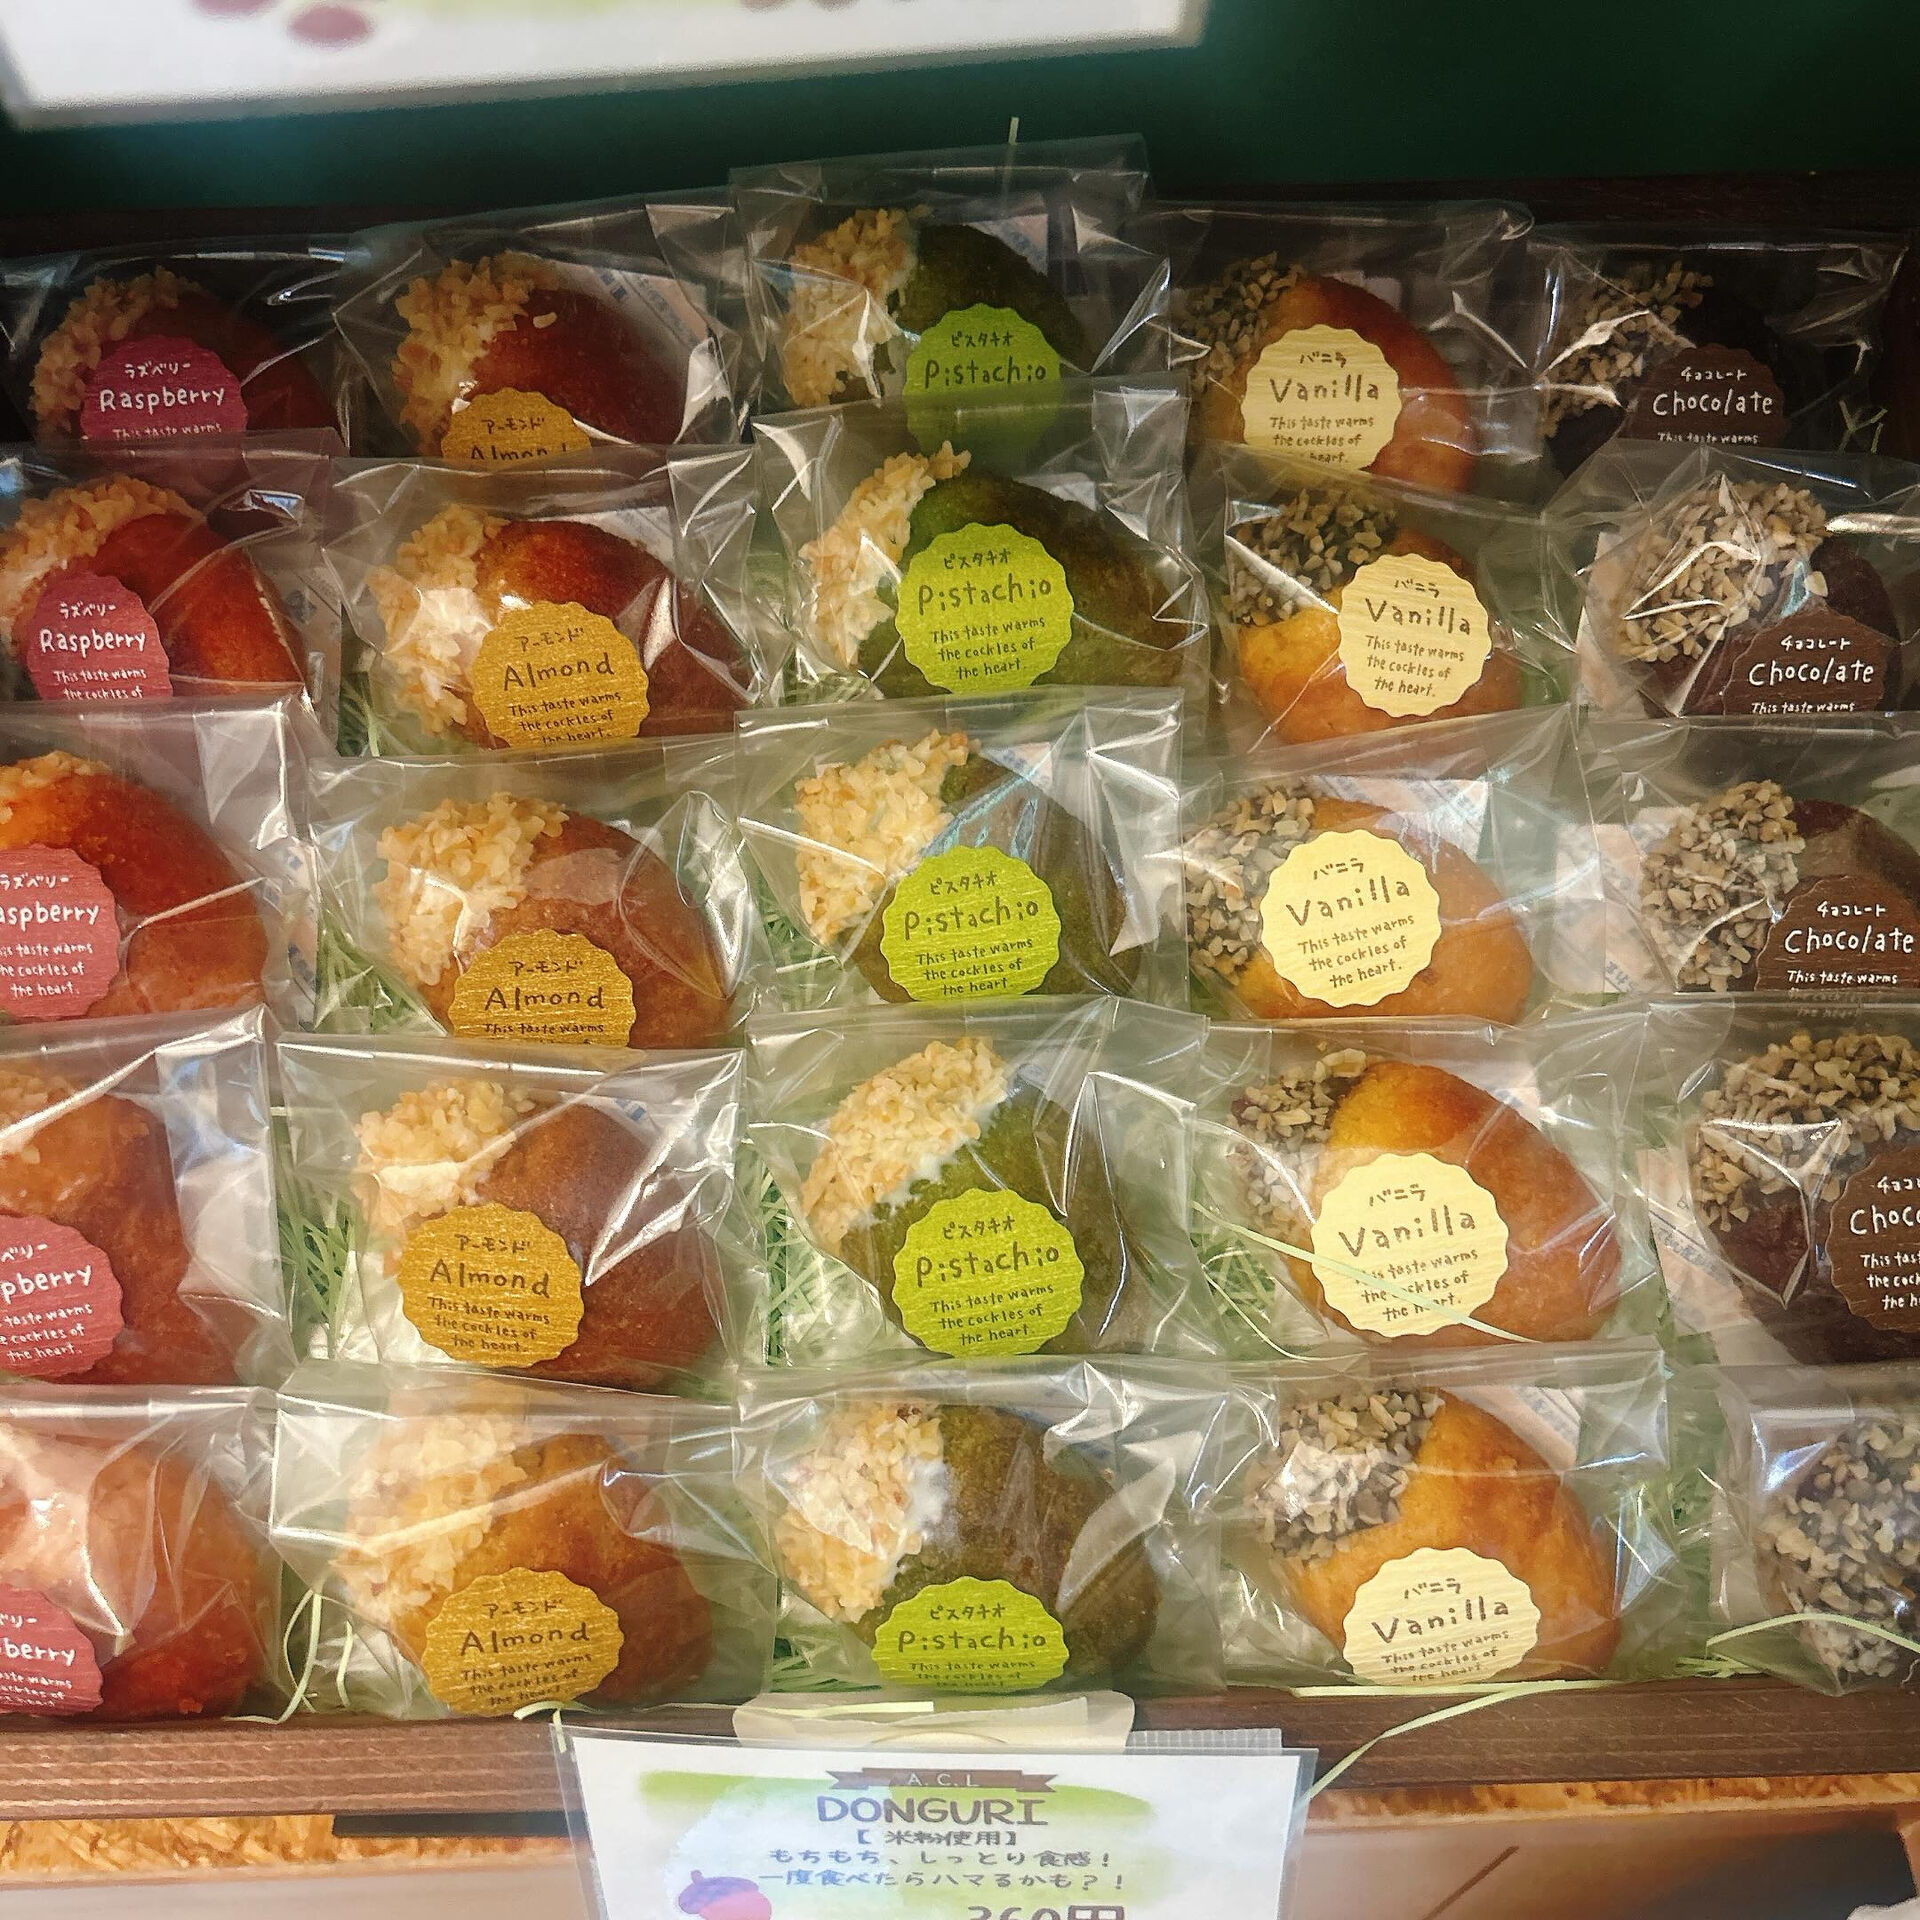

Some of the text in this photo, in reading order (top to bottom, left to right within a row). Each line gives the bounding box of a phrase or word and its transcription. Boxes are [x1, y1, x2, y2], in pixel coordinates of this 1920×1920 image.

[951, 329, 1013, 348] ピスタチオ
[125, 361, 191, 379] ラズベリー
[1300, 351, 1347, 368] バニラ
[924, 355, 1047, 389] Pistachio
[1270, 374, 1379, 403] Vanilla
[100, 386, 225, 416] Raspberry
[1653, 388, 1773, 416] Chocolate
[1270, 416, 1374, 430] This taste warms
[1273, 434, 1293, 446] the
[1348, 434, 1362, 446] of
[944, 548, 1011, 569] ピスタチオ
[918, 573, 1051, 616] Pistachio
[1394, 579, 1439, 598] バニラ
[60, 601, 116, 619] ラズベリー
[1365, 598, 1470, 636] Vanilla
[931, 617, 1045, 643] This taste warms
[40, 628, 145, 658] Raspberry
[938, 637, 1035, 661] the cockles of
[1365, 634, 1464, 661] This taste warms
[54, 668, 147, 684] This taste warms
[504, 652, 614, 691] Almond
[957, 666, 978, 679] the
[1367, 655, 1451, 679] the cockles of
[1749, 657, 1874, 686] Chocolate
[131, 685, 143, 699] of
[1374, 677, 1393, 692] the
[508, 692, 621, 717] This taste warms
[1752, 702, 1855, 715] This taste warms
[519, 709, 613, 731] the cockles of
[1314, 858, 1364, 880] バニラ
[930, 870, 997, 895] ピスタチオ
[1286, 875, 1410, 926] Vanilla
[1817, 900, 1887, 918] チョコレート
[904, 896, 1039, 941] Pistachio
[1297, 915, 1415, 955] This taste warms
[1784, 925, 1914, 954] Chocolate
[16, 944, 49, 957] taste
[53, 943, 93, 954] warms
[915, 938, 1033, 965] This taste warms
[1309, 935, 1407, 972] the cockles of
[18, 964, 69, 976] cockles
[71, 961, 84, 975] of
[509, 961, 583, 976] アーモンド
[924, 958, 1022, 981] the cockles of
[1329, 958, 1402, 988] the heart.
[1787, 970, 1898, 984] This taste warms
[11, 984, 33, 998] the
[485, 986, 605, 1011] Almond
[942, 984, 964, 996] the
[484, 1023, 604, 1034] This taste warms
[1369, 1184, 1426, 1206] バニラ
[942, 1215, 1015, 1240] ピスタチオ
[1338, 1205, 1476, 1257] Vanilla
[1850, 1205, 1920, 1235] Choc
[454, 1234, 530, 1253] アーモンド
[916, 1241, 1059, 1288] Pistachio
[1431, 1249, 1478, 1268] warms
[1860, 1255, 1890, 1268] This
[429, 1258, 550, 1299] Almond
[1361, 1270, 1469, 1303] the of
[1866, 1275, 1889, 1288] the
[427, 1296, 550, 1325] This taste warms
[930, 1285, 1054, 1313] This taste warms
[1882, 1295, 1904, 1310] the
[5, 1312, 42, 1328] taste
[46, 1304, 93, 1321] warms
[939, 1304, 1043, 1330] the cockles of
[1382, 1307, 1408, 1321] the
[11, 1323, 85, 1344] cockles of
[435, 1315, 537, 1340] the cockles of
[959, 1333, 983, 1346] the
[452, 1336, 474, 1348] the
[6, 1350, 31, 1362] the
[1404, 1578, 1461, 1599] バニラ
[930, 1603, 1005, 1620] ピスタチオ
[1372, 1596, 1508, 1643] Vanilla
[461, 1622, 590, 1656] Almond
[899, 1627, 1046, 1653] Pistachio
[1381, 1653, 1414, 1663] This
[1462, 1631, 1509, 1647] warms
[0, 1637, 74, 1666] berry
[463, 1654, 591, 1680] This taste warms
[816, 1795, 1049, 1826] DONGURI
